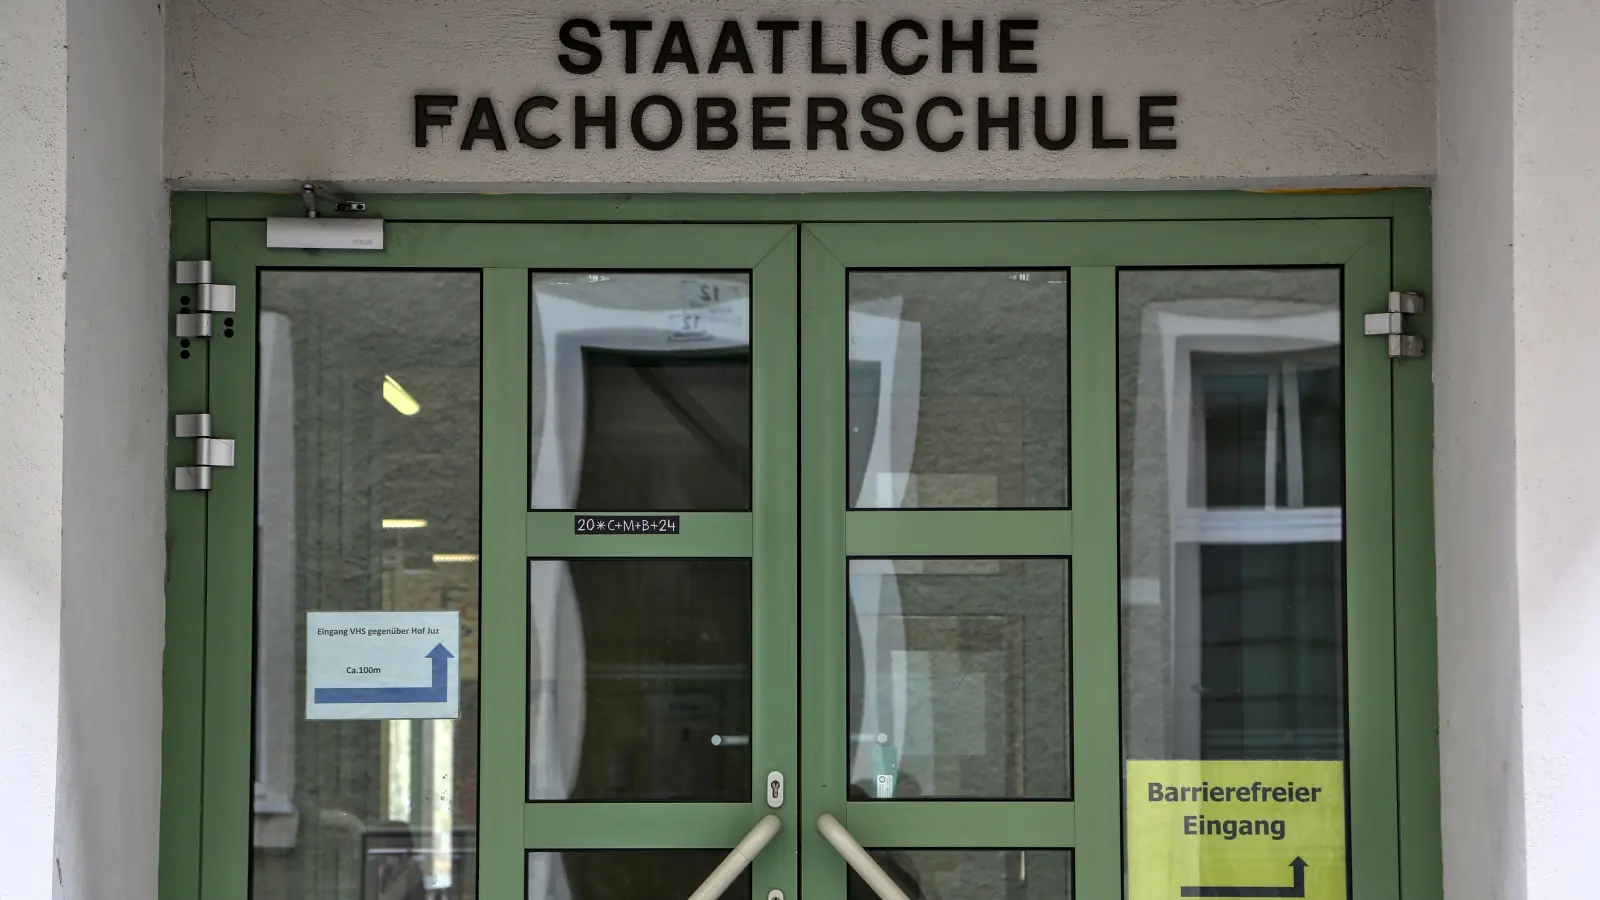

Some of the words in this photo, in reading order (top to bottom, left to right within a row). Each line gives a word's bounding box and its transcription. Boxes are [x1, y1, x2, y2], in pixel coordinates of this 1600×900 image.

[557, 17, 1039, 75] STAATLICHE
[412, 92, 1178, 153] FACHOBERSCHULE
[317, 627, 348, 636] Eingang
[350, 627, 366, 635] VHS
[367, 627, 409, 636] gegenüber
[411, 626, 426, 635] Hof
[427, 627, 440, 635] Juz
[346, 666, 381, 674] Ca.100m
[1147, 781, 1322, 803] Barrierefreier
[1184, 814, 1285, 841] Eingang
